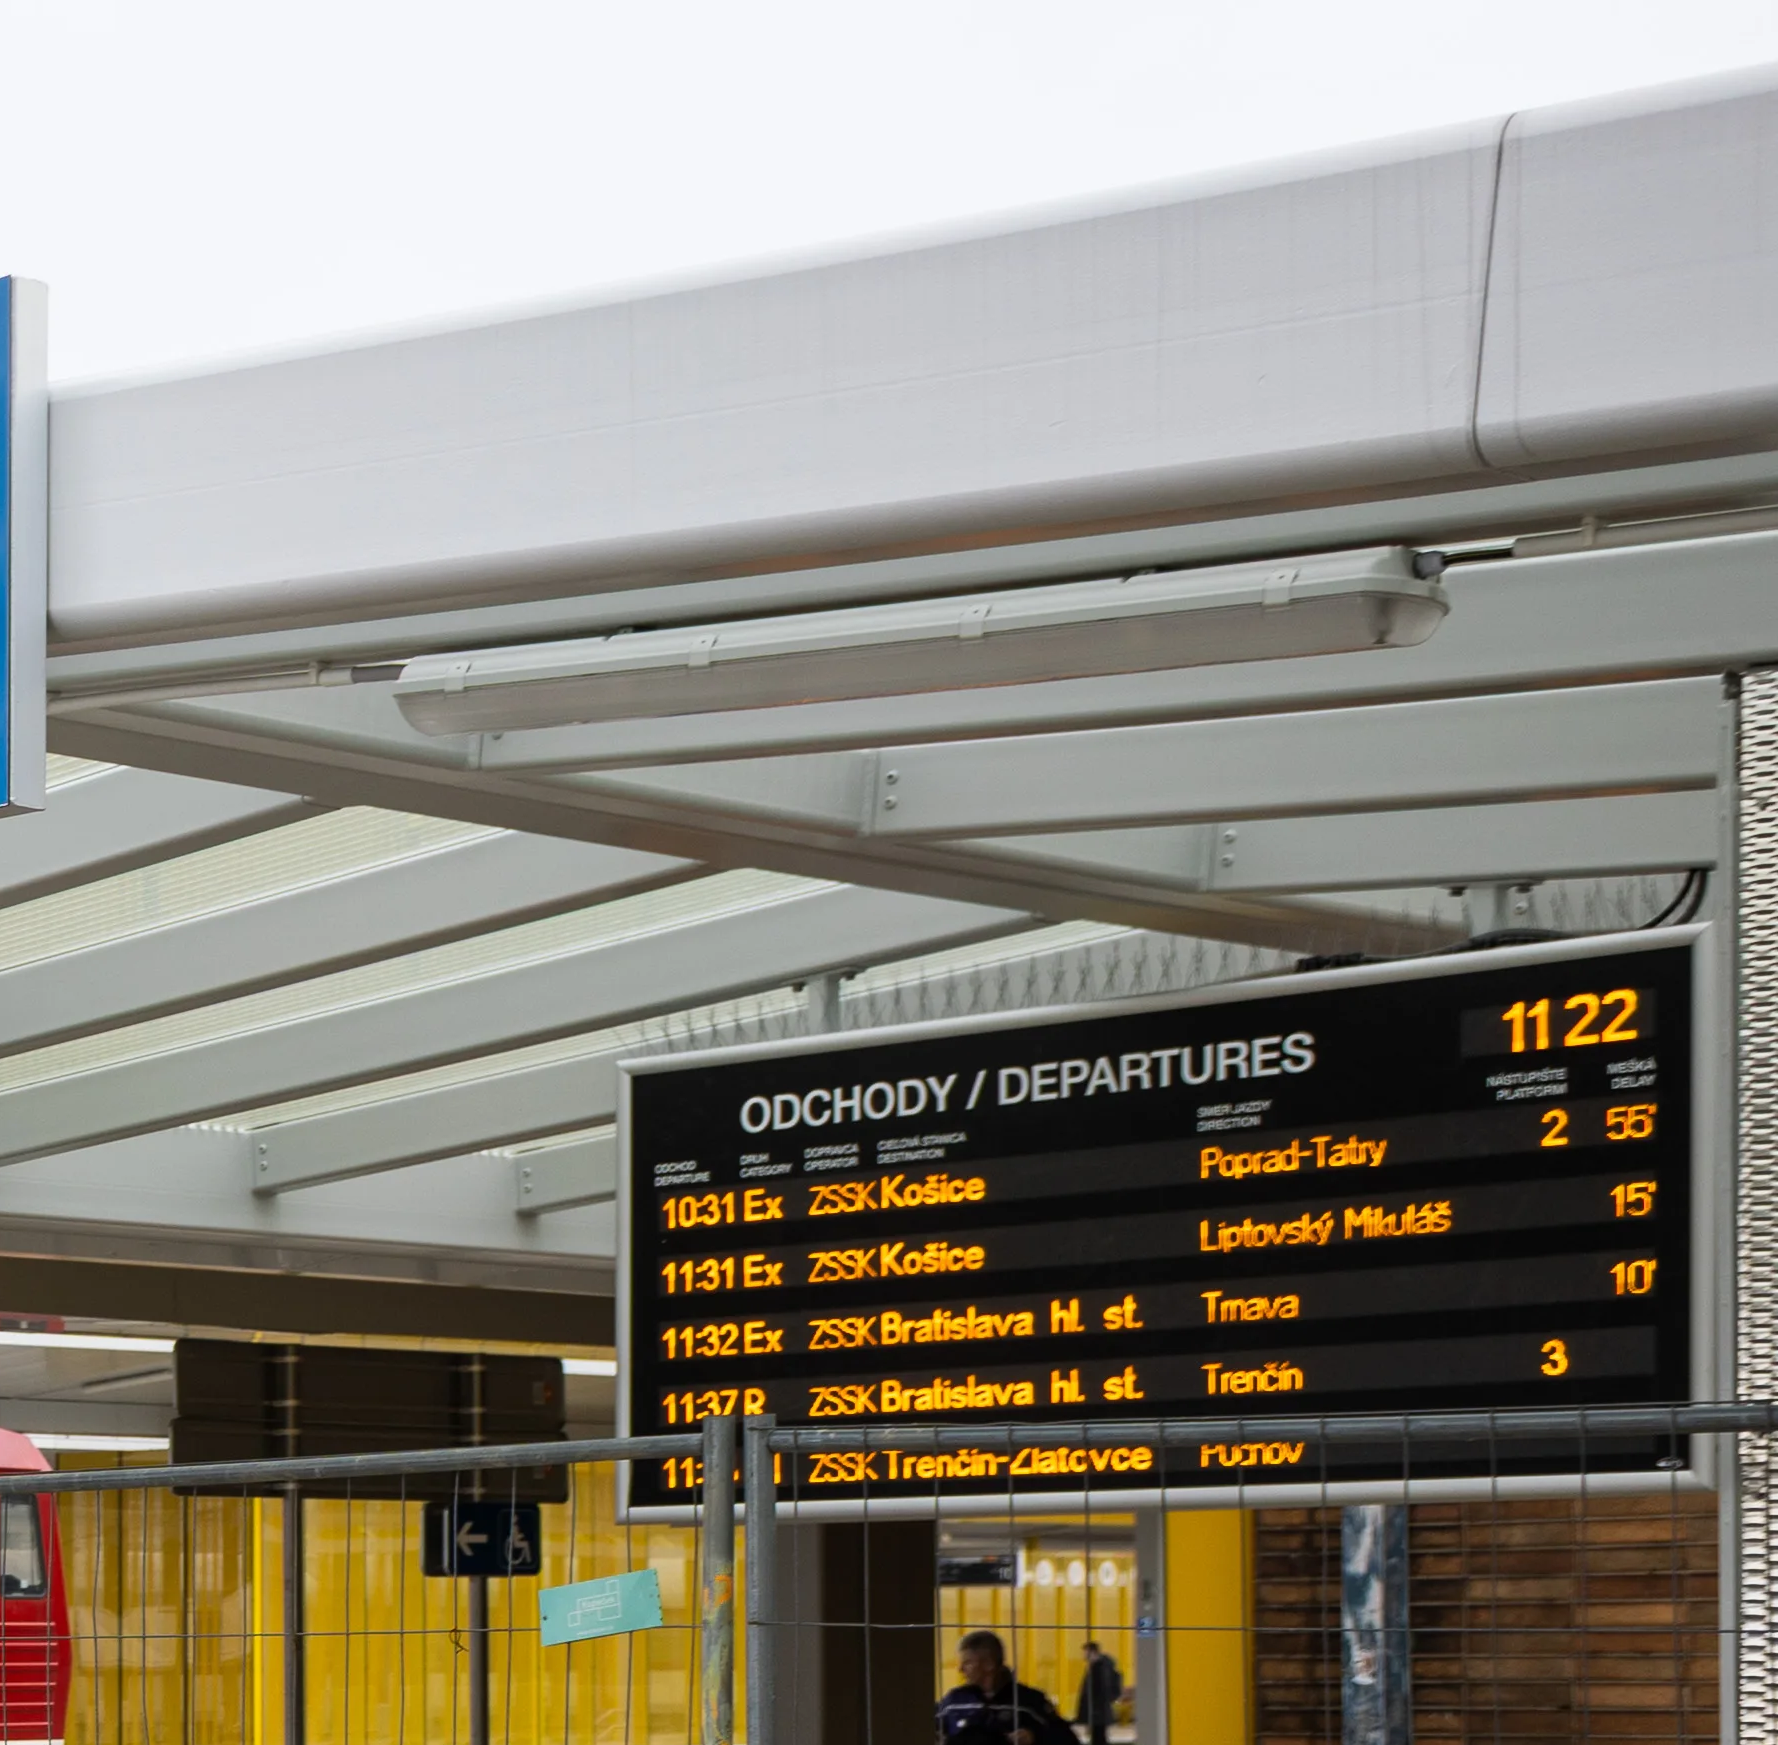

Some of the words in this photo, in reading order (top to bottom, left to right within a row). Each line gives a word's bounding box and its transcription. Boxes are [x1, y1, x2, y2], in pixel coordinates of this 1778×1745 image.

[740, 1074, 958, 1133] ODCHODY
[997, 1033, 1316, 1106] DEPARTURES
[1486, 1067, 1568, 1087] NÁSTUPIŠTE
[1611, 1074, 1656, 1090] DELAY
[1496, 1083, 1568, 1101] PLATFORM
[1197, 1115, 1261, 1132] DIRECTION
[804, 1156, 859, 1172] OPERATOR
[877, 1148, 945, 1164] DESTINATION
[662, 1191, 736, 1230] 10:31
[743, 1187, 784, 1222] Ex
[807, 1180, 878, 1216] ZSSK
[880, 1173, 986, 1209] Košice
[1200, 1135, 1388, 1180] Poprad-Tatry
[1540, 1108, 1569, 1147] 2
[739, 1163, 793, 1178] CATEGORY
[654, 1171, 711, 1187] DEPARTURE
[661, 1256, 735, 1294] 11:31
[743, 1253, 784, 1289] Ex
[807, 1247, 878, 1284] ZSSK
[880, 1241, 986, 1278] Košice
[1200, 1210, 1335, 1253] Liptovský
[1344, 1200, 1453, 1240] Mikuláš
[661, 1322, 740, 1360] 11:32
[743, 1319, 785, 1355] Ex
[807, 1315, 878, 1351] ZSSK
[880, 1305, 1035, 1346] Bratislava
[1103, 1294, 1144, 1331] st.
[662, 1388, 740, 1425] 11:37
[743, 1387, 767, 1415] R
[808, 1384, 879, 1417] ZSSK
[880, 1374, 1036, 1413] Bratislava
[1103, 1364, 1145, 1401] st.
[1200, 1360, 1304, 1395] Trenčín
[1540, 1338, 1569, 1377] 3
[808, 1451, 880, 1484] ZSSK
